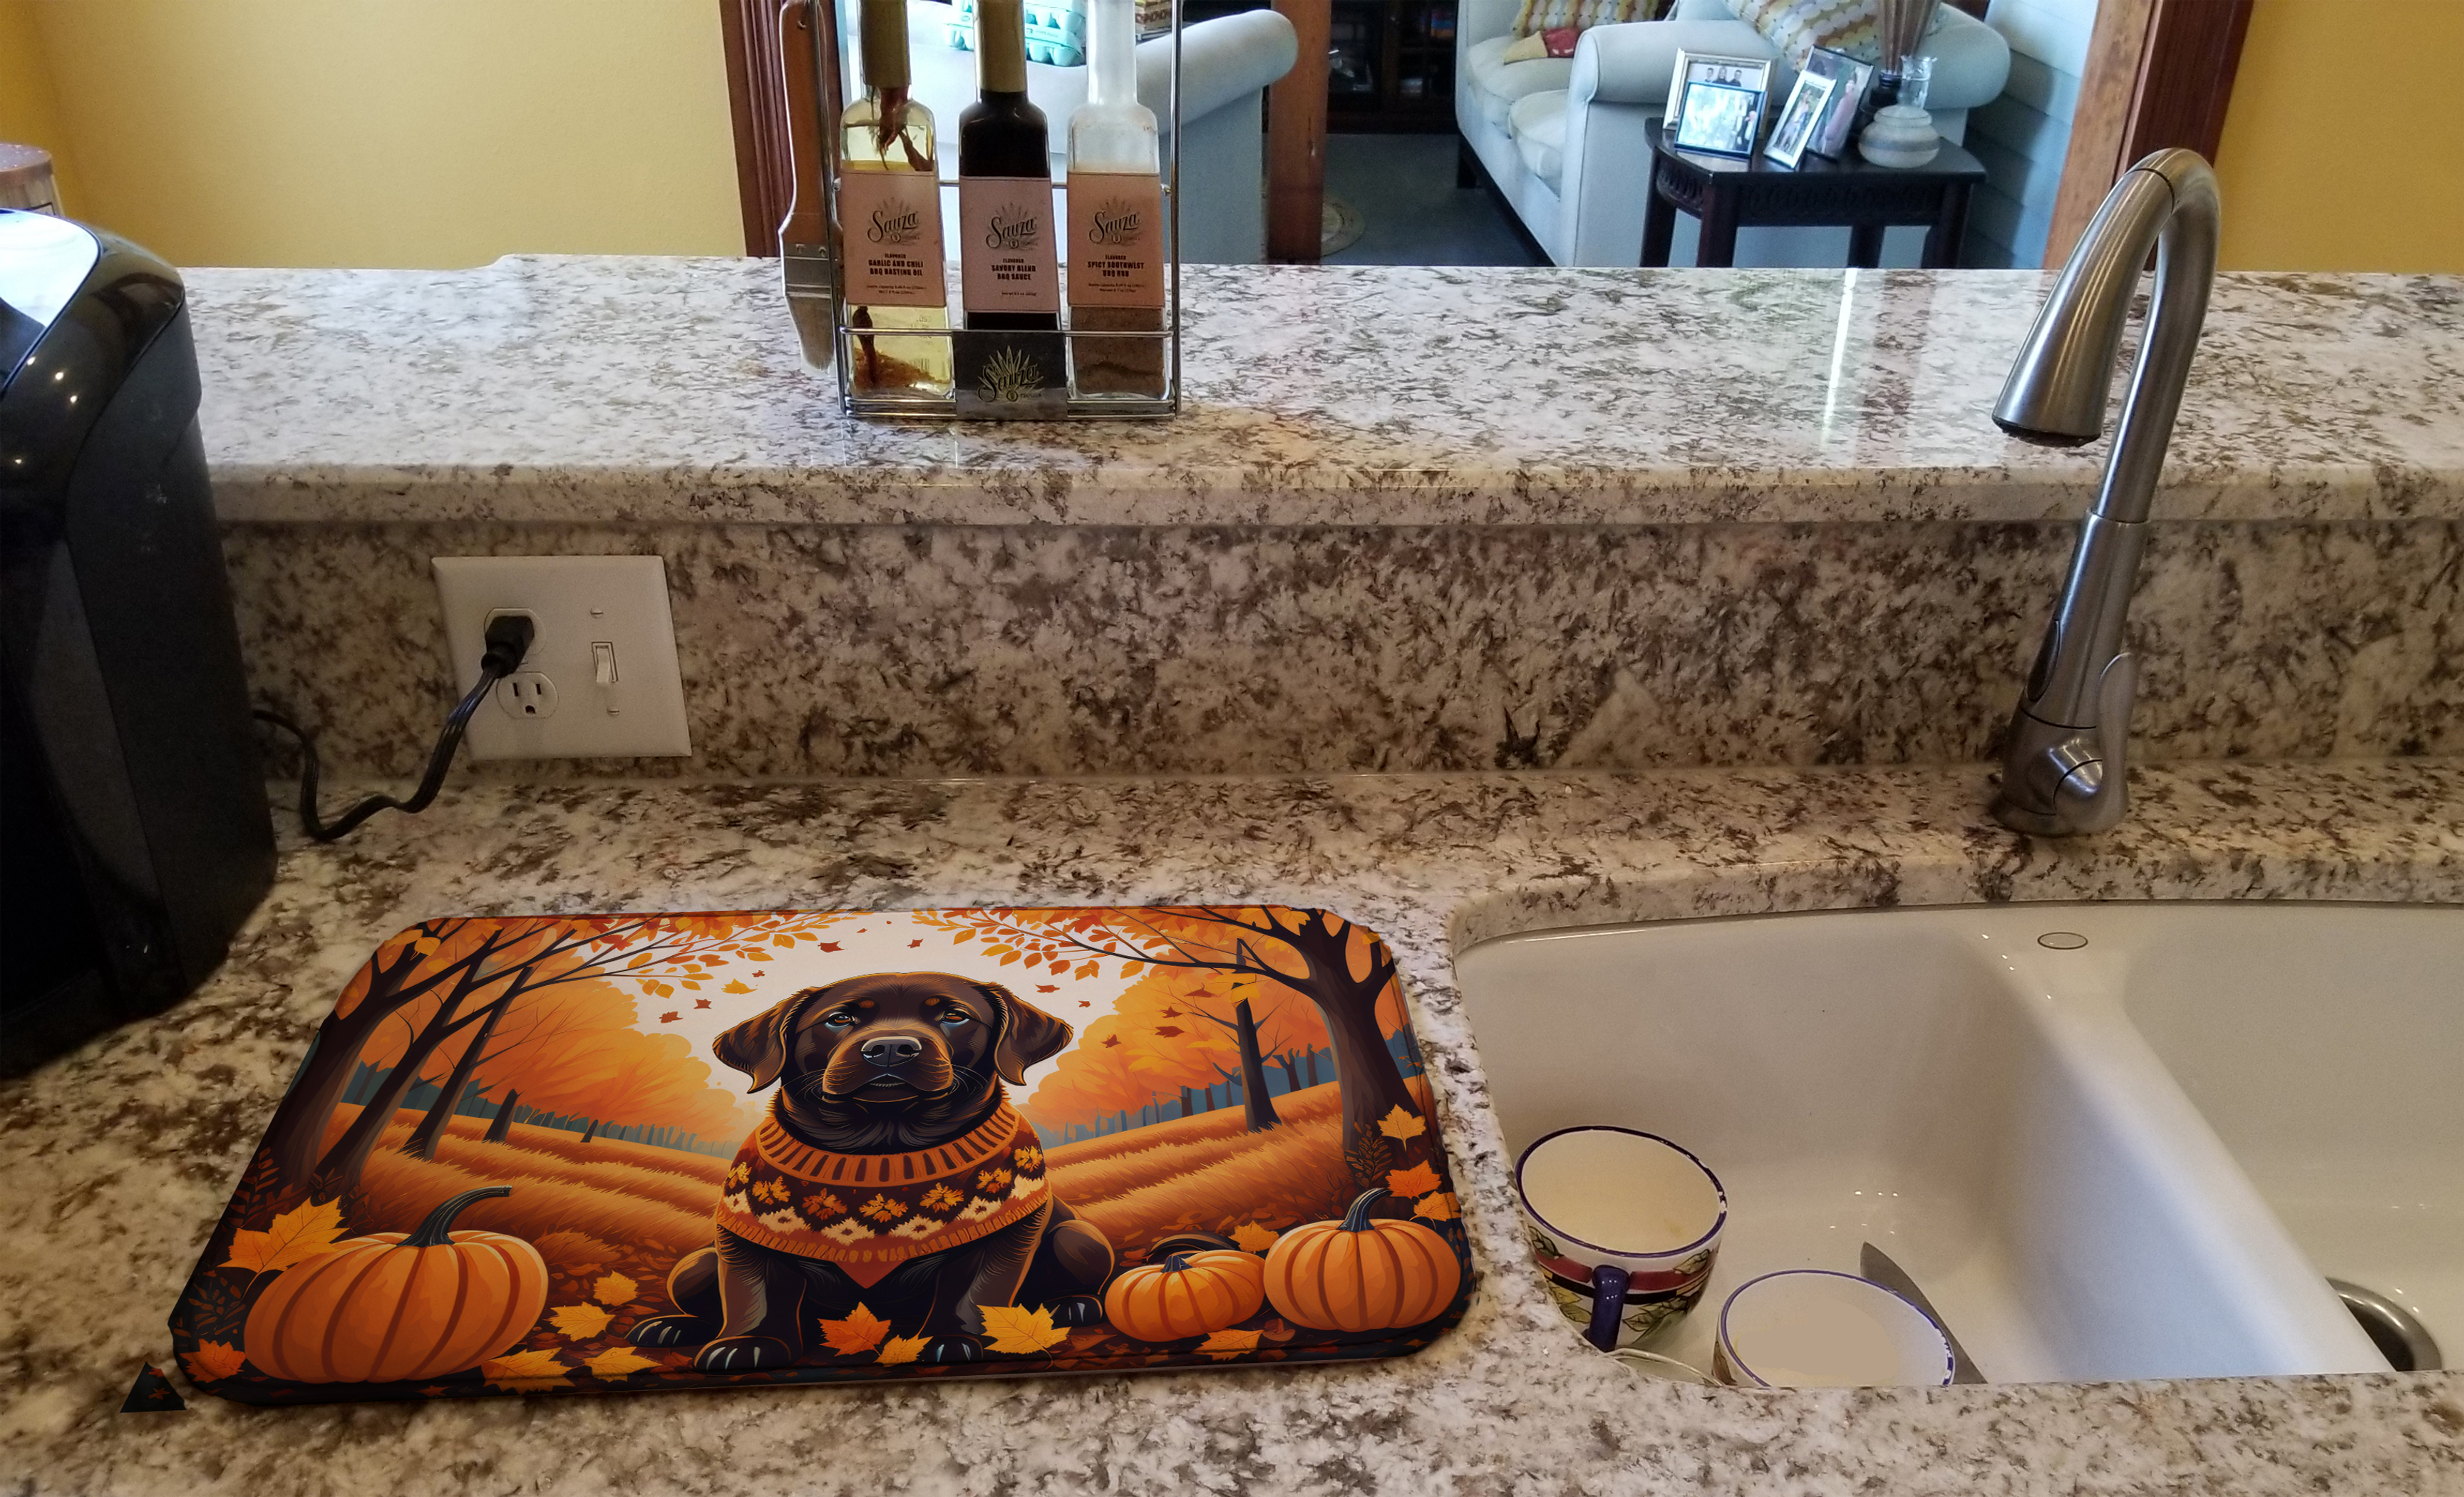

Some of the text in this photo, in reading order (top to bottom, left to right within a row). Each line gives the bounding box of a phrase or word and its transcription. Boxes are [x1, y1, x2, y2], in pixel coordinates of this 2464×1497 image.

[867, 210, 919, 243] Sauza
[986, 216, 1037, 249] Sauza
[1089, 211, 1140, 244] Sauza
[1108, 261, 1145, 269] SOUTHWEST
[977, 364, 1041, 403] Sauza
